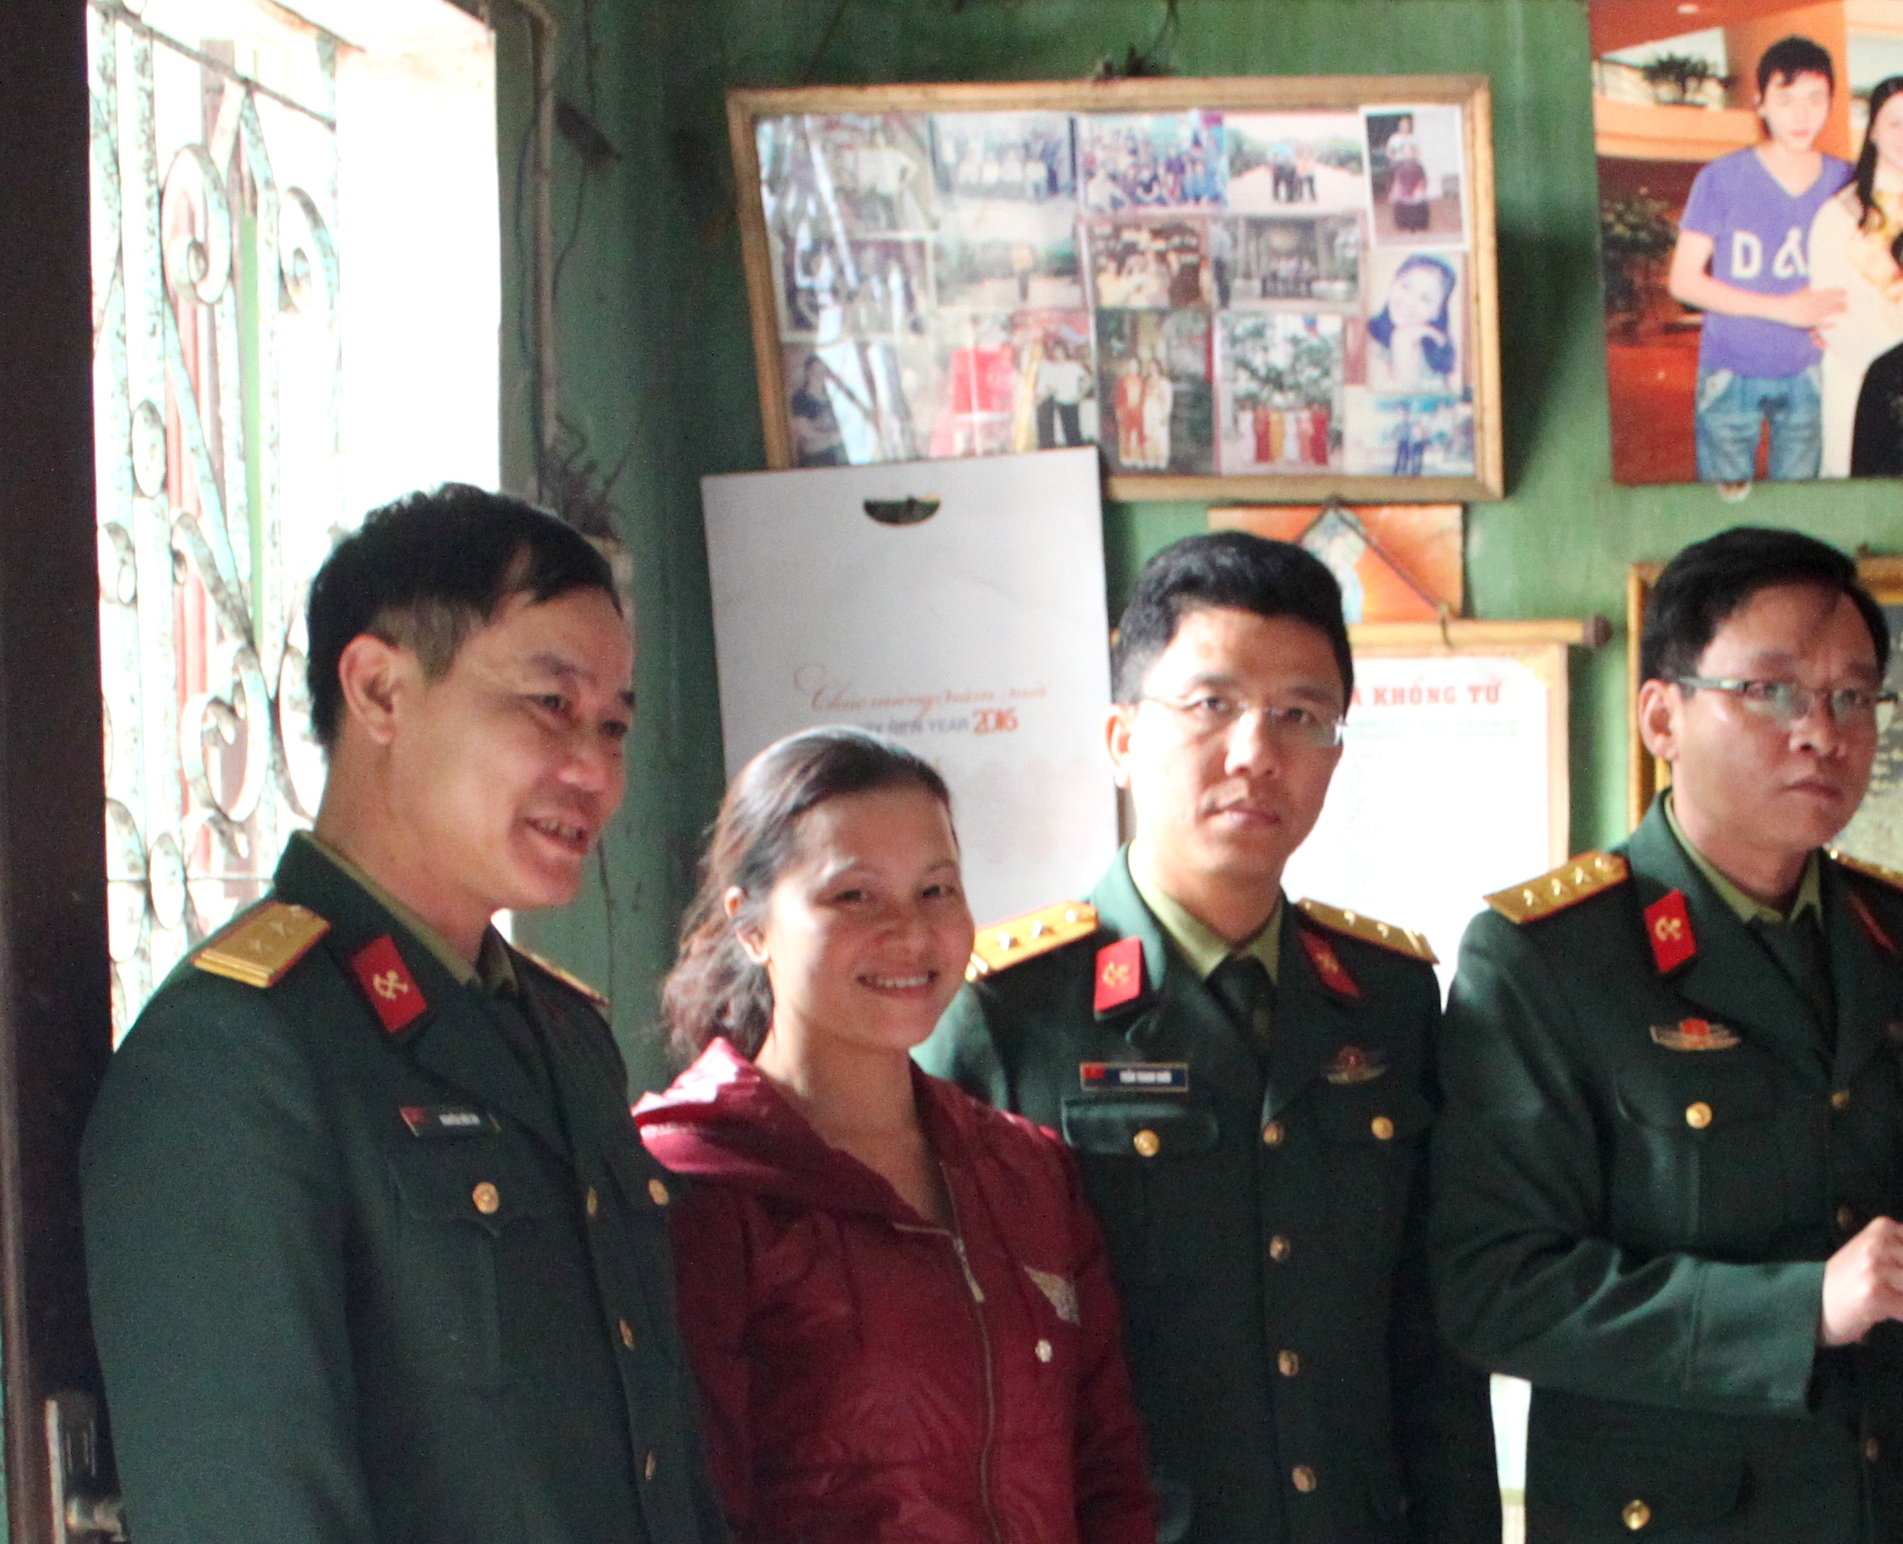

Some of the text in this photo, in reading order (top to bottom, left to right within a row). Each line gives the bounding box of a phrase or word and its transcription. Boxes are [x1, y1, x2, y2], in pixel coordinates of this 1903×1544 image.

[887, 717, 923, 734] NEW
[928, 716, 969, 732] YEAR
[972, 707, 1019, 735] 2016
